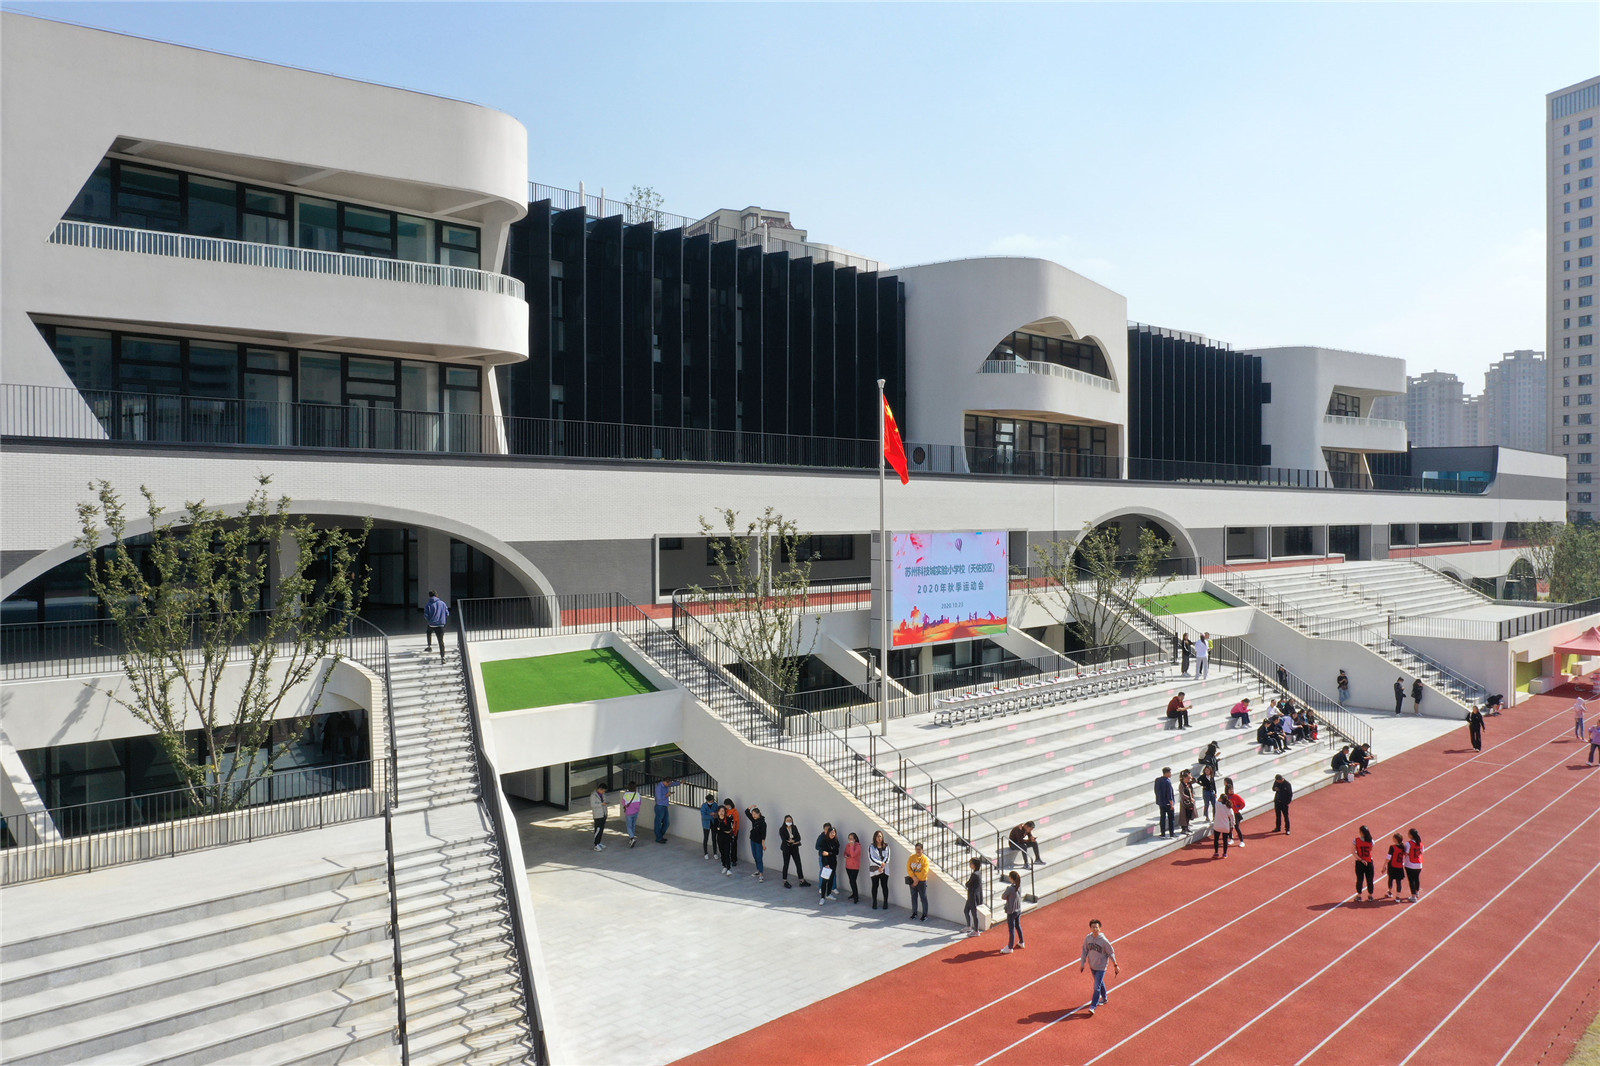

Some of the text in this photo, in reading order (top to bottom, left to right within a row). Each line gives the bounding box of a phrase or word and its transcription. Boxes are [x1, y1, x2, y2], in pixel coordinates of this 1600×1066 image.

[917, 580, 985, 594] 2020年秋季运动会
